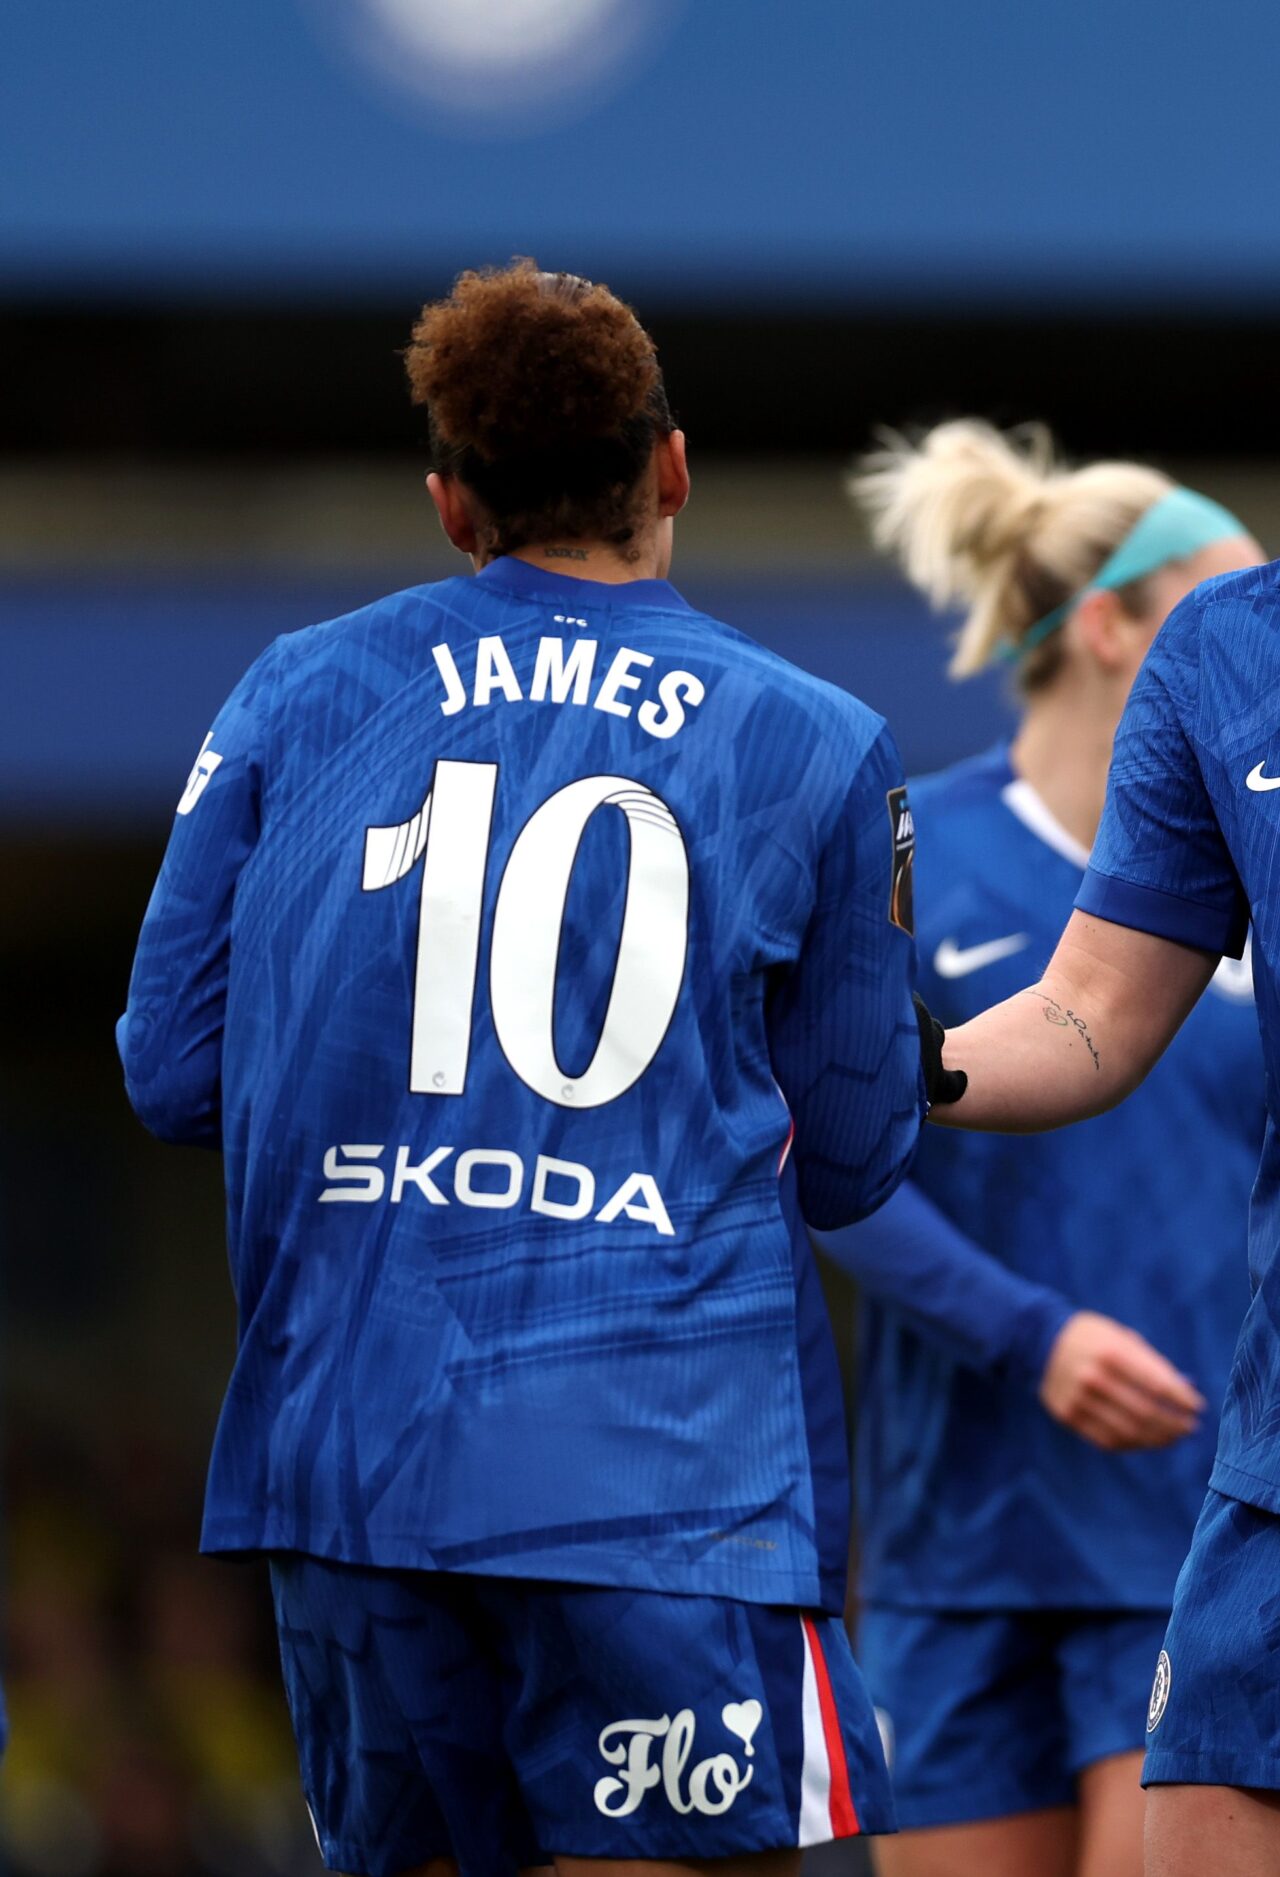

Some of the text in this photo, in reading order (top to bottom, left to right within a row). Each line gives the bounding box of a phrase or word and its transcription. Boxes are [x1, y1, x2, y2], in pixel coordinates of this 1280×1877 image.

[431, 635, 706, 740] JAMES
[362, 758, 691, 1109] 10
[593, 1707, 754, 1818] Flo
